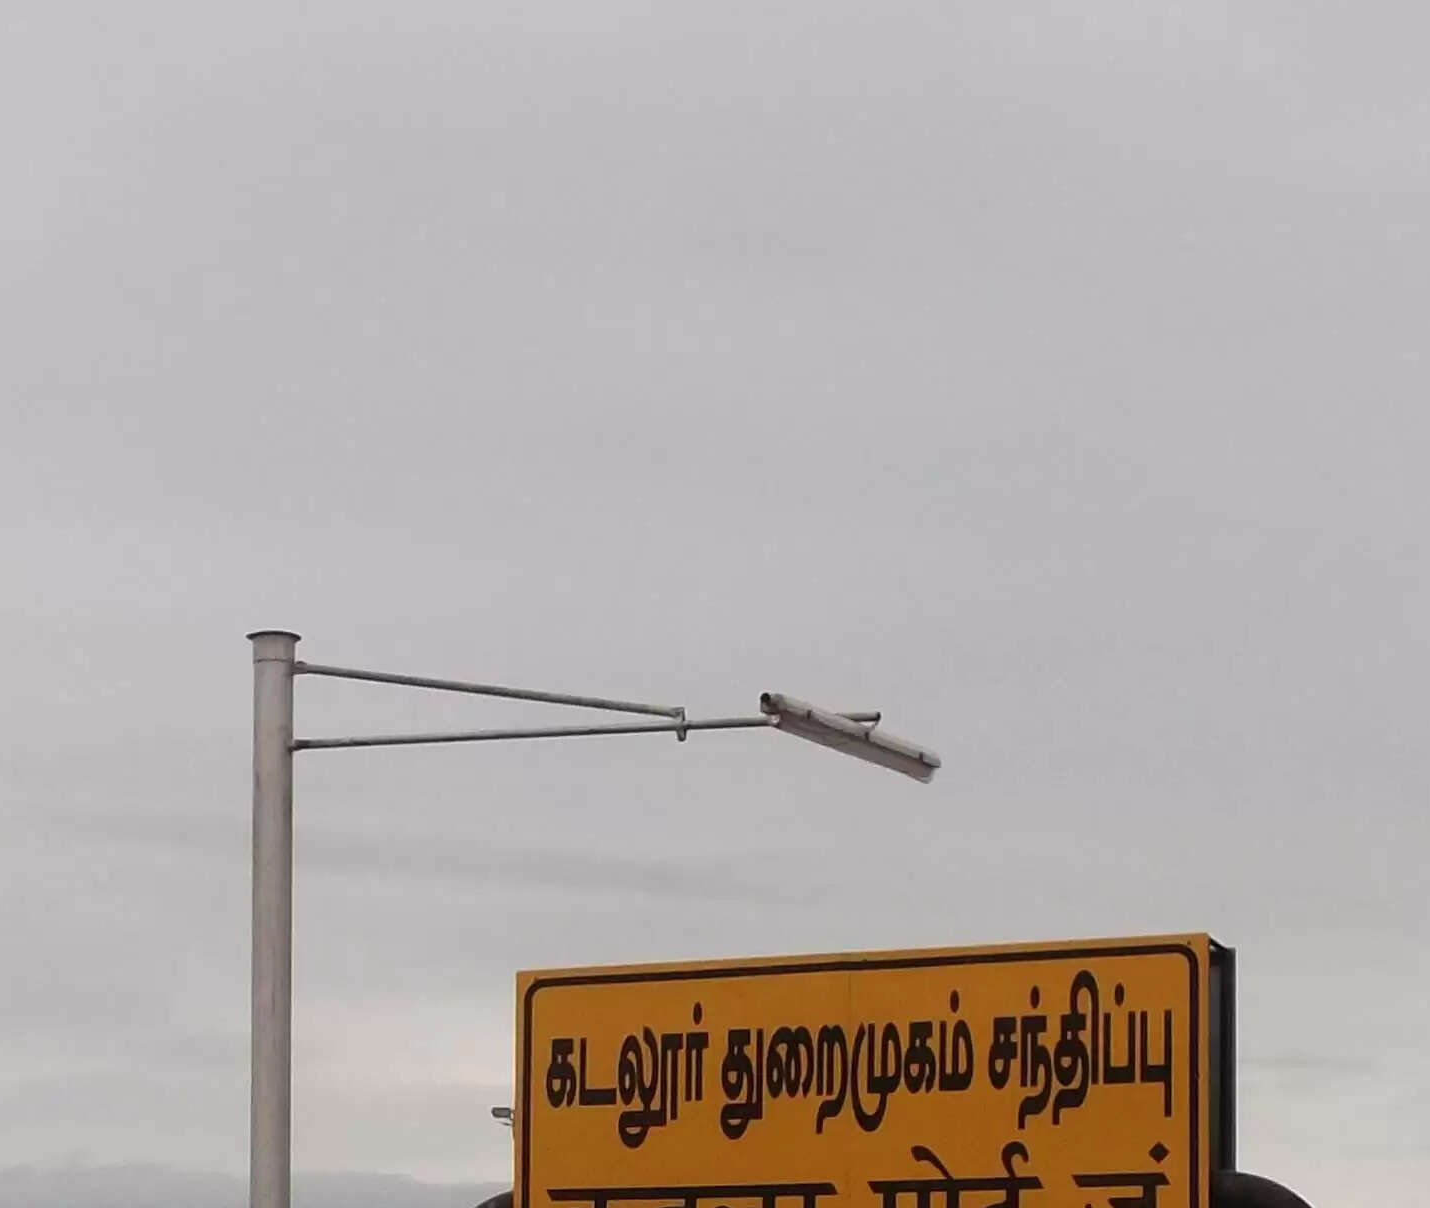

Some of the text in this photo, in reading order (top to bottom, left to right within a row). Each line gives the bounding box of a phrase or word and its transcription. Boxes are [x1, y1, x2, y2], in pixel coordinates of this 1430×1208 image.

[546, 970, 1173, 1148] கடலூர் துறைமுகம் சந்திப்பு
